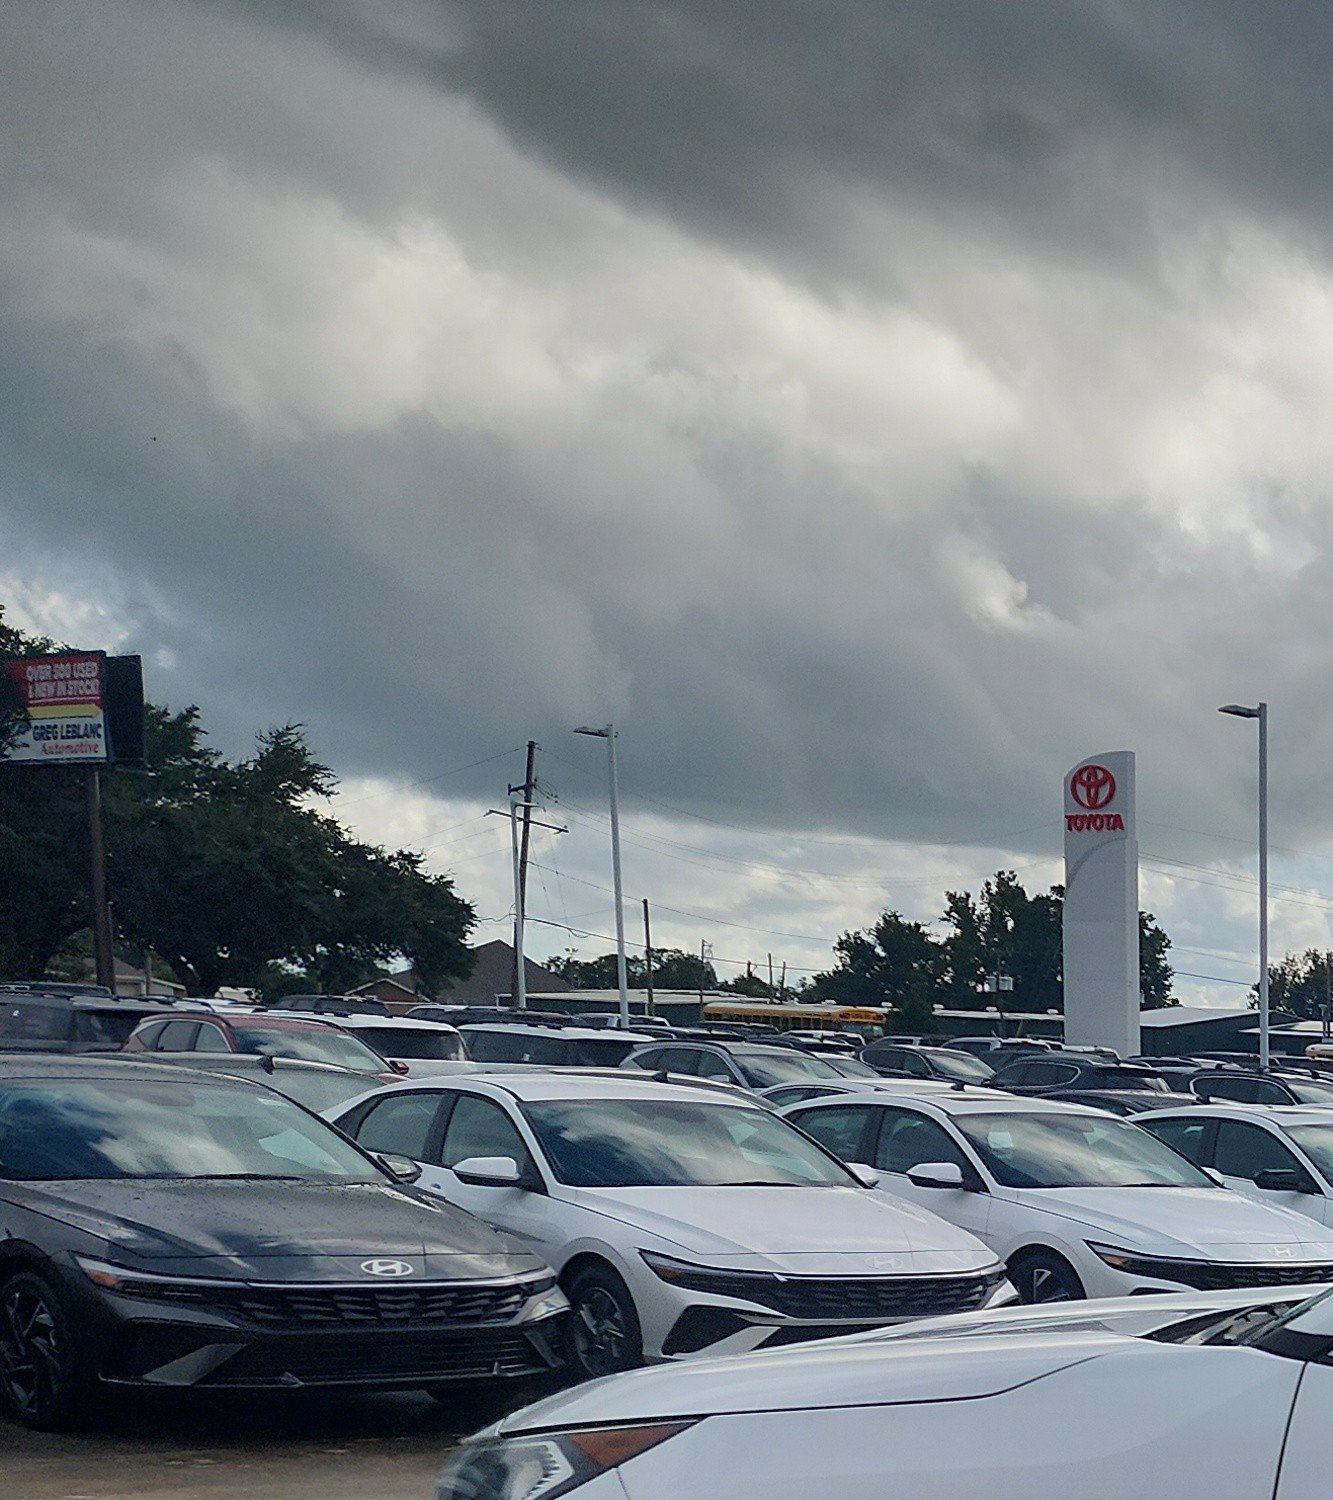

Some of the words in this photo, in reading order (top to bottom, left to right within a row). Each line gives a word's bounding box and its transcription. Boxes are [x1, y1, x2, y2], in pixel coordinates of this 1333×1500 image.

[33, 724, 59, 741] GREG
[60, 723, 102, 740] LEBLANC
[42, 742, 99, 755] Automotive
[1065, 814, 1125, 831] TOYOTA
